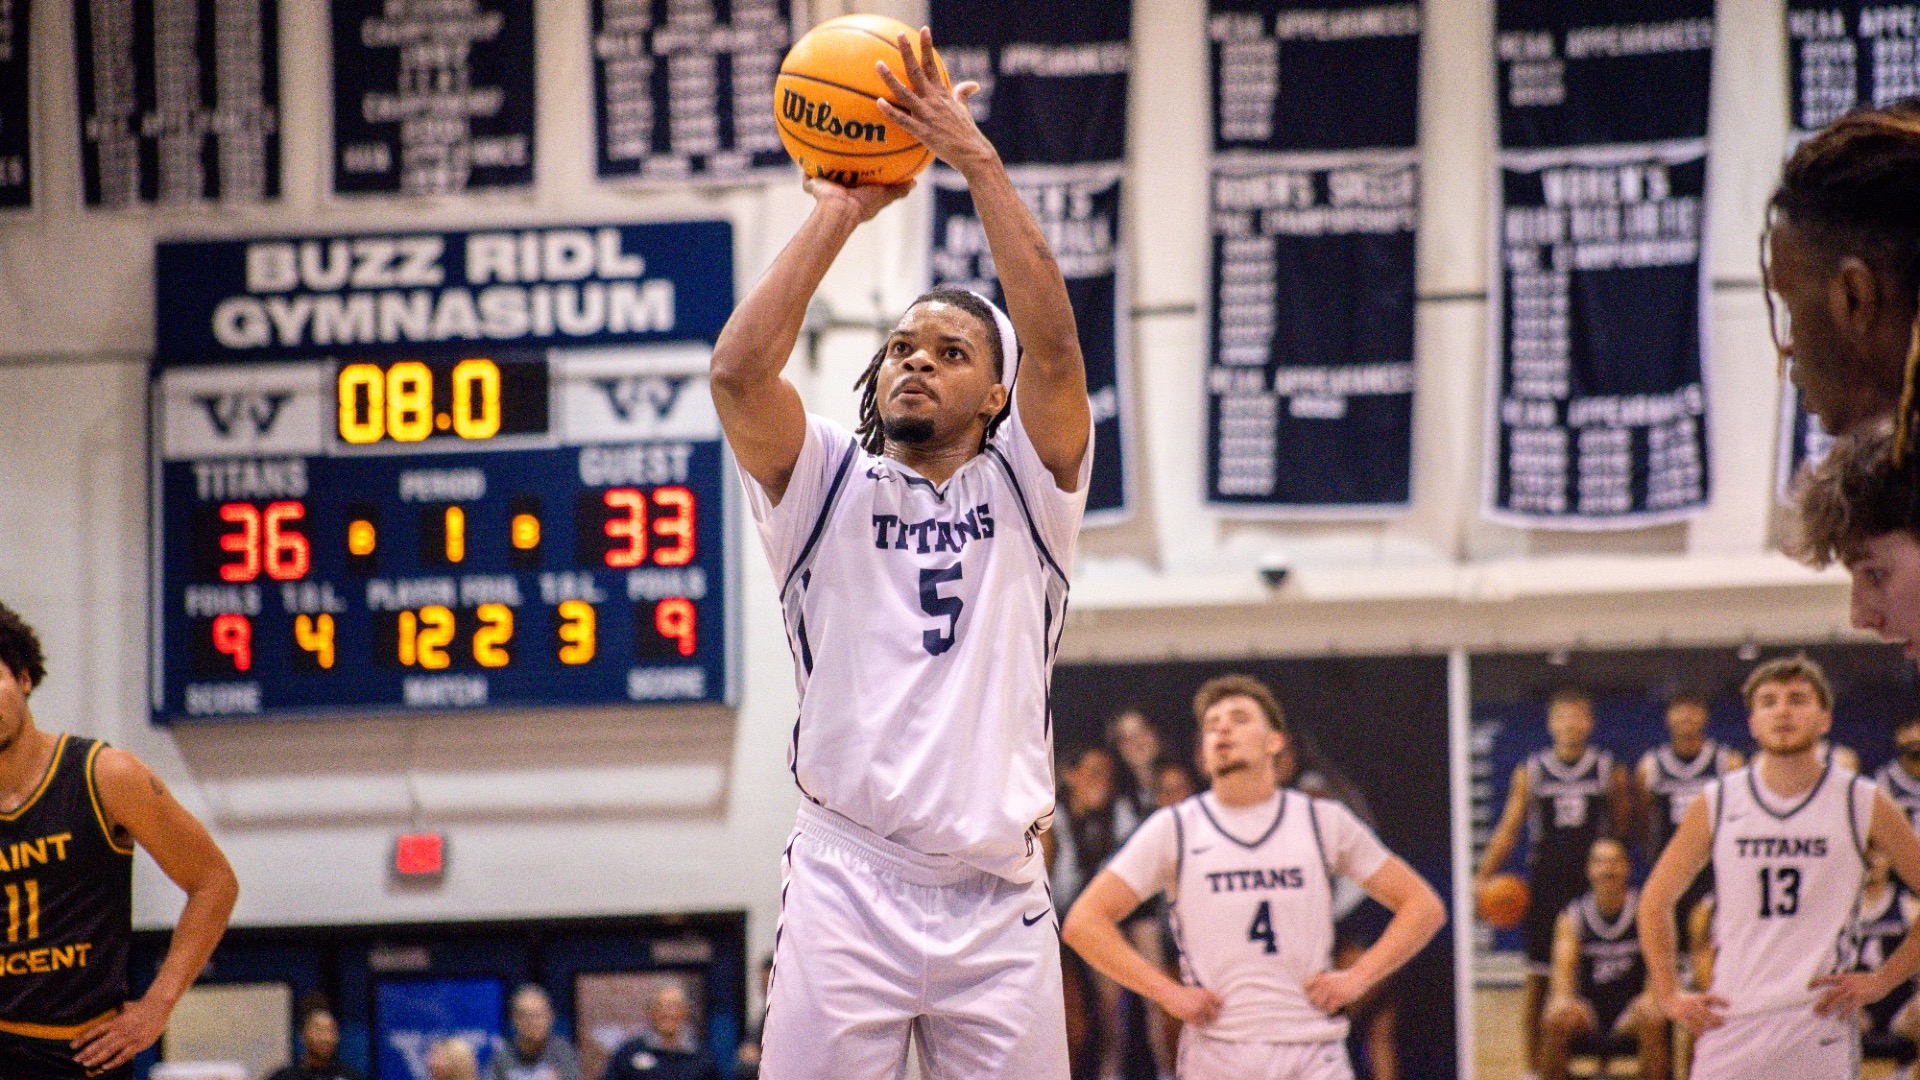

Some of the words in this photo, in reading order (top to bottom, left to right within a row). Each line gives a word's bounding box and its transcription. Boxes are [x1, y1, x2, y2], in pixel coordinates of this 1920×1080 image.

[783, 88, 886, 142] Wilson
[246, 236, 445, 293] BUZZ
[465, 229, 646, 285] RIDL
[212, 279, 676, 349] GYMNASIUM
[338, 358, 501, 444] 08.0
[219, 501, 310, 582] 36
[445, 506, 465, 563] 1
[604, 486, 696, 569] 33
[872, 503, 995, 555] TITANS
[398, 603, 456, 670] 12
[472, 602, 515, 668] 2
[558, 600, 597, 665] 3
[655, 595, 697, 656] 9
[918, 562, 964, 656] 5
[212, 612, 251, 672] 9
[294, 612, 336, 669] 4
[1735, 837, 1828, 858] TITANS
[1205, 867, 1303, 893] TITANS
[1758, 866, 1800, 919] 13
[4, 879, 40, 943] 11
[1247, 900, 1279, 955] 4
[0, 943, 92, 977] CENT
